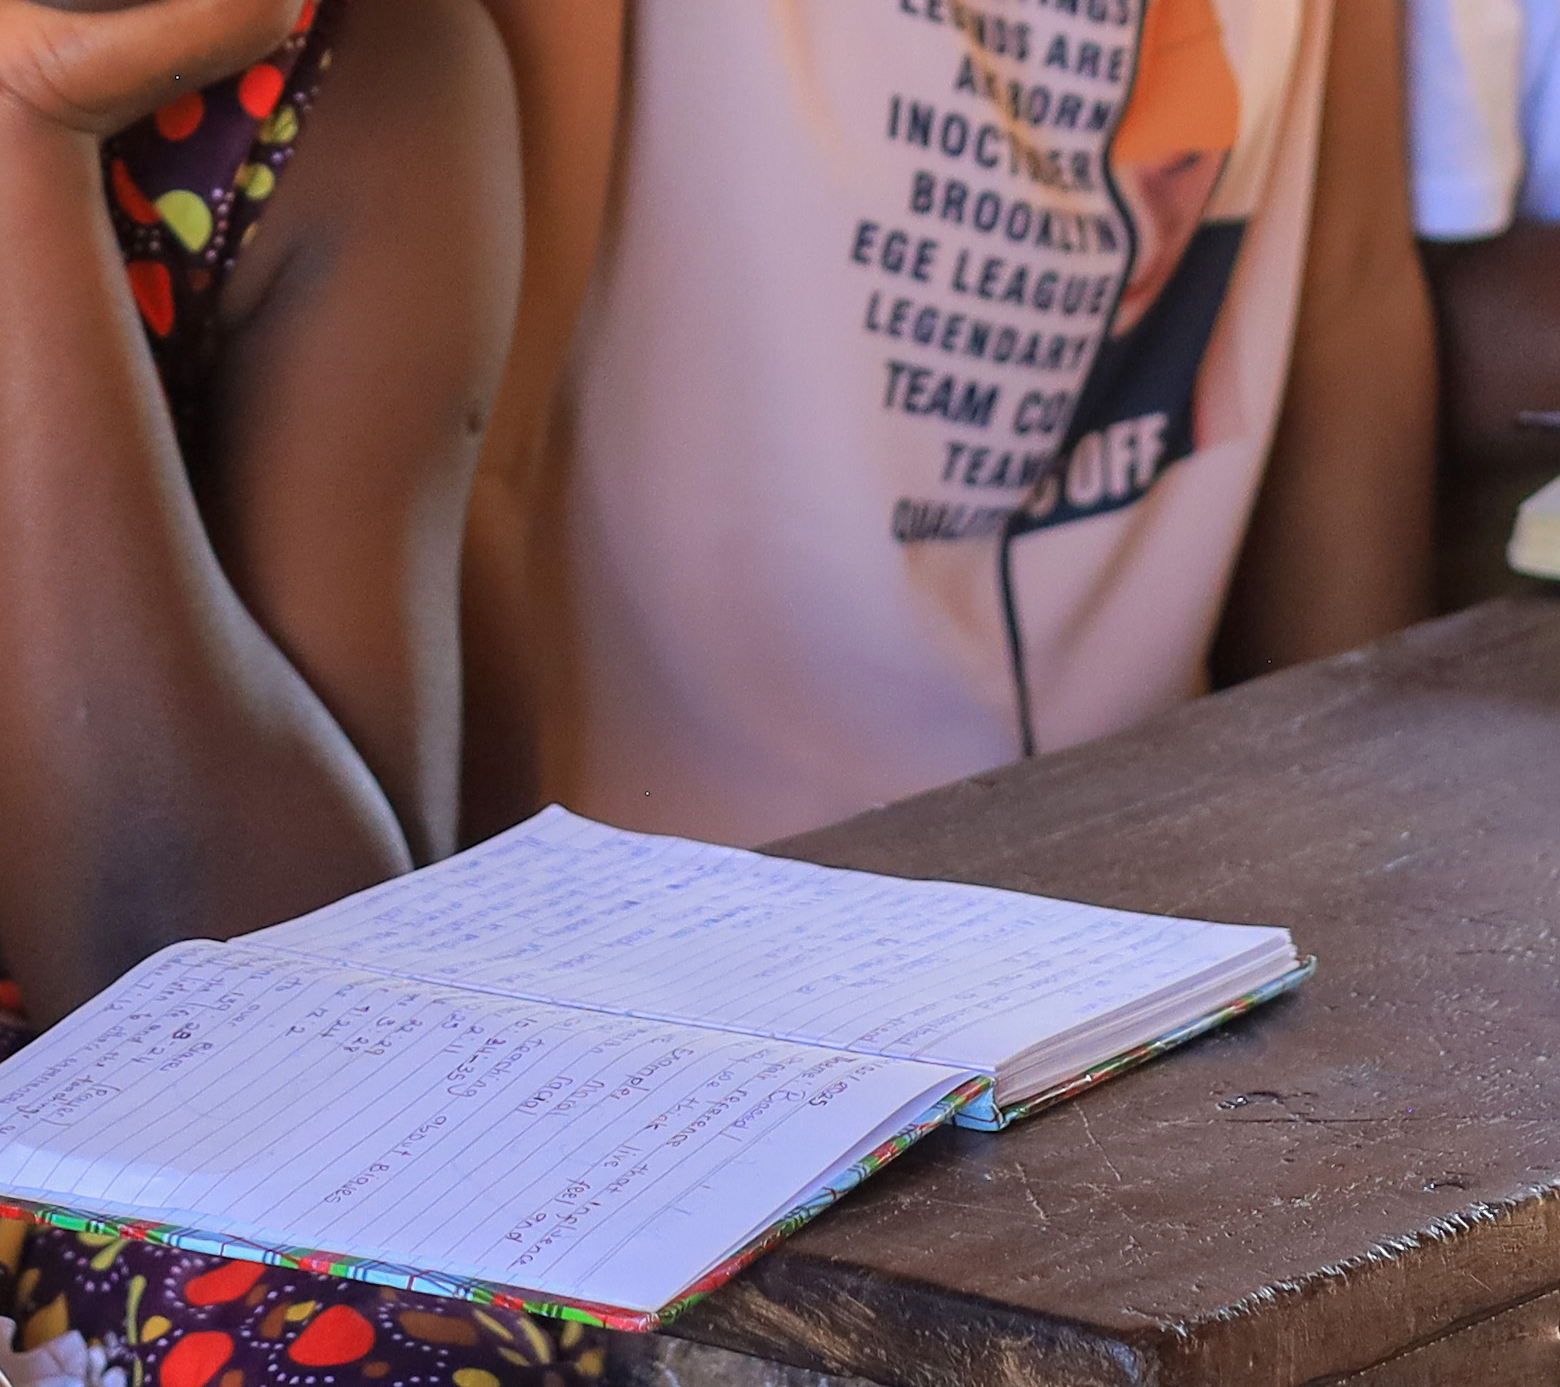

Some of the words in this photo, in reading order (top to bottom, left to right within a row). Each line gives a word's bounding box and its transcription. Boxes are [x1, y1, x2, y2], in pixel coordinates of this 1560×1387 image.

[1046, 33, 1126, 84] ARE
[851, 217, 941, 284] EGE
[951, 246, 1112, 318] LEAGUE
[865, 288, 1090, 372] LEGENDARY
[883, 359, 1000, 431] TEAM
[445, 1038, 544, 1098] teaching
[642, 1096, 698, 1130] think
[386, 1115, 447, 1156] about
[592, 1142, 641, 1167] live
[548, 1178, 591, 1205] feel
[604, 1161, 648, 1193] that
[503, 1212, 561, 1243] and
